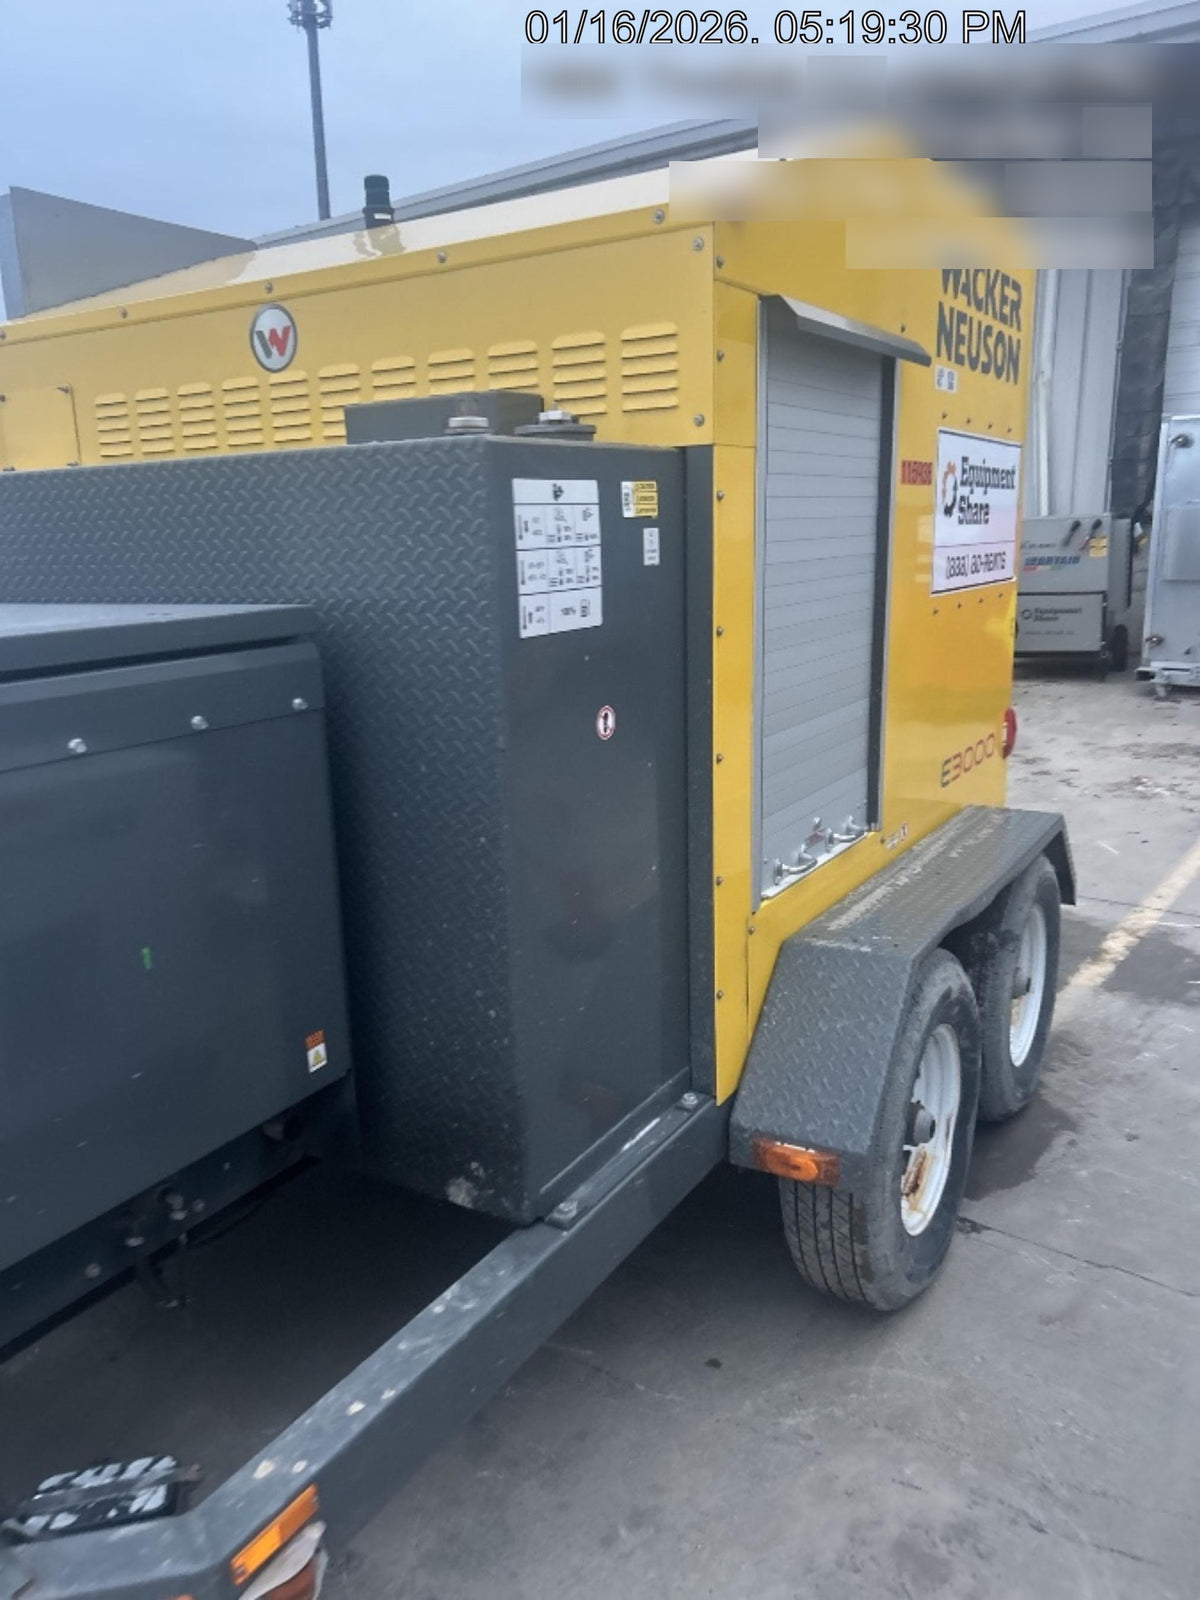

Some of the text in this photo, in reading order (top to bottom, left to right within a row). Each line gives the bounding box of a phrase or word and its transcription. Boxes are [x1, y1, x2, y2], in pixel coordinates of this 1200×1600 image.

[936, 300, 1021, 386] NEUSON
[960, 456, 1016, 495] Equipment
[958, 495, 990, 525] Share
[940, 732, 995, 788] E3000
